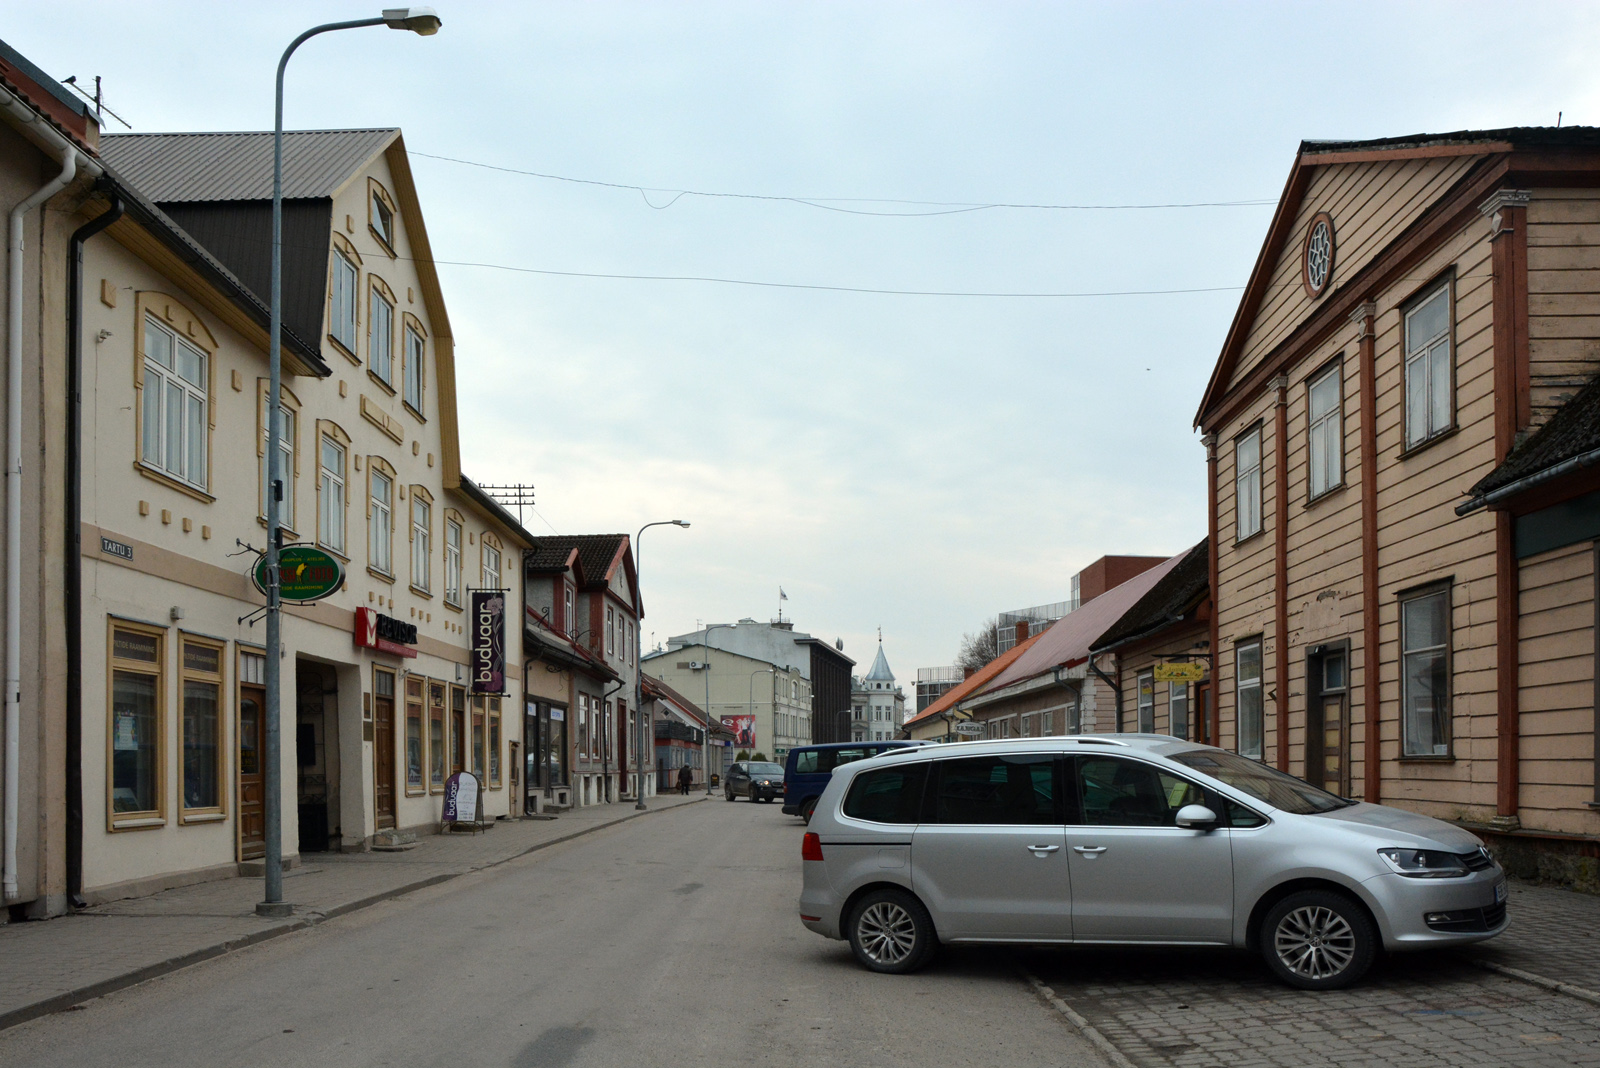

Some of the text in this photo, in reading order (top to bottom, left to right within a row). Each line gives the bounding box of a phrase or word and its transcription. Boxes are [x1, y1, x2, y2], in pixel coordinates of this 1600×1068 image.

[103, 540, 132, 557] TARTU 3
[309, 567, 334, 580] FOTO
[377, 613, 418, 645] REVISOR
[129, 642, 155, 653] RAAMIMINE
[475, 602, 492, 682] buduaar
[446, 781, 458, 816] buduaar
